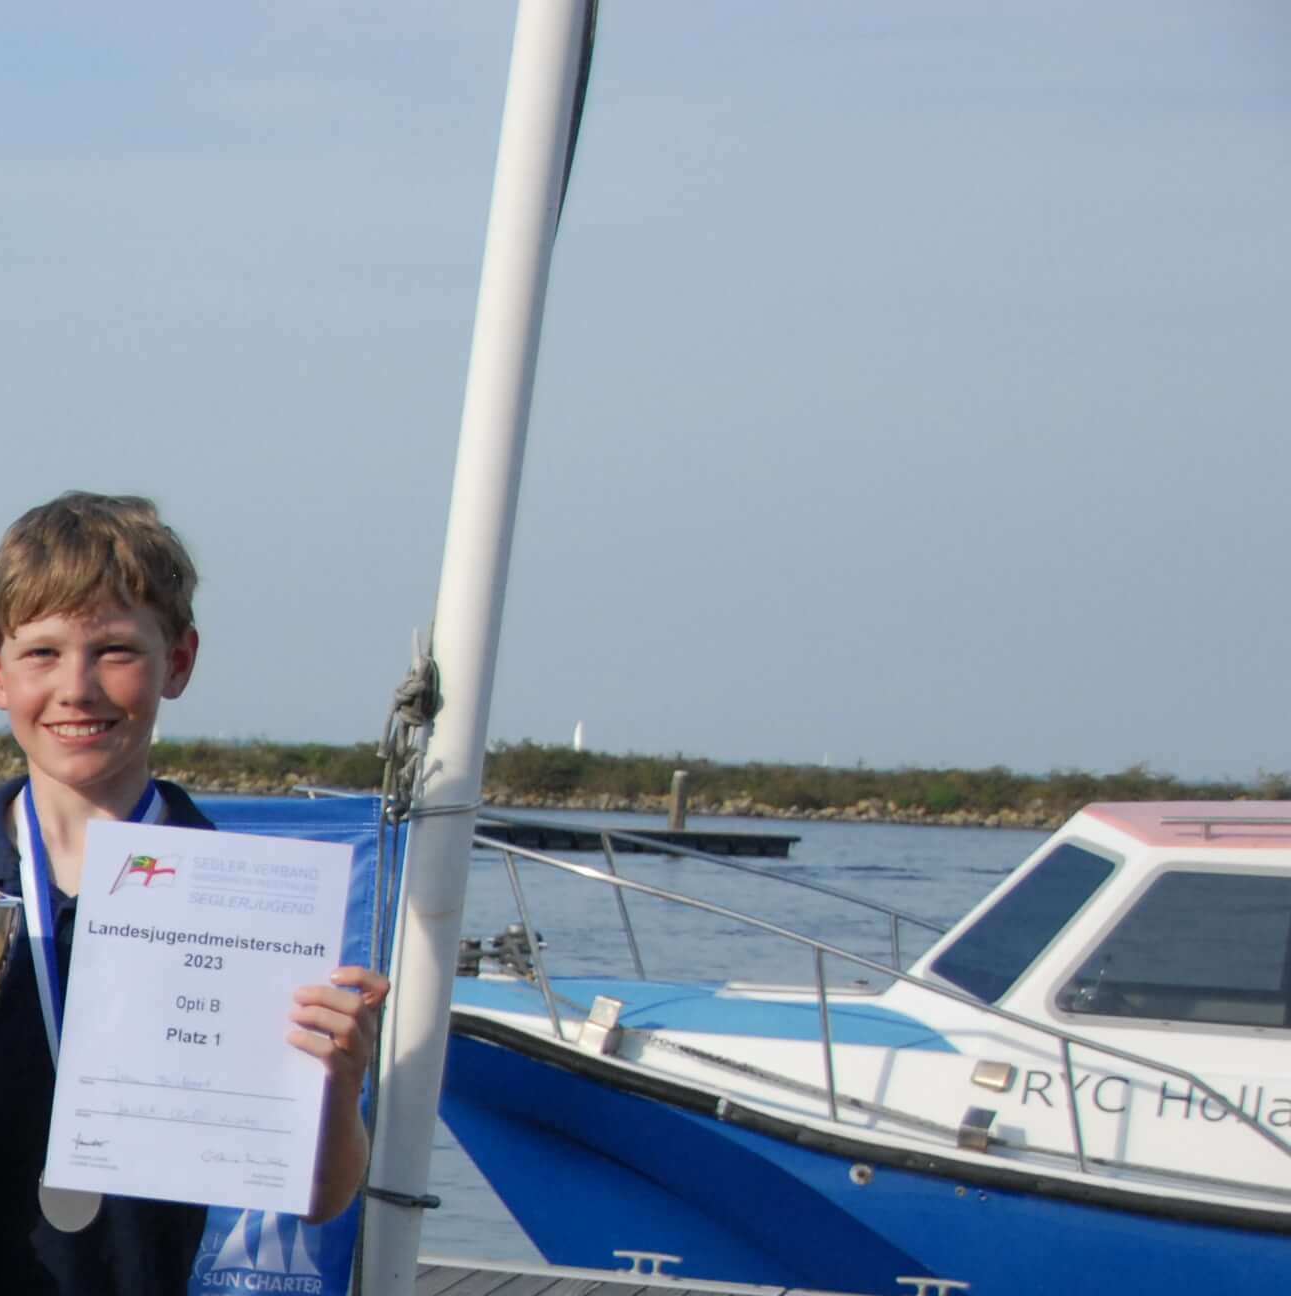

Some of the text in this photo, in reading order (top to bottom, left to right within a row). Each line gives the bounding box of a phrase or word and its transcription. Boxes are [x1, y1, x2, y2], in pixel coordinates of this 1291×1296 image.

[88, 920, 326, 958] Landesjugendmeisterschaft
[184, 953, 223, 971] 2023
[176, 996, 220, 1014] Opti B
[166, 1028, 221, 1046] Platz 1
[1021, 1069, 1131, 1113] RYC
[202, 1272, 322, 1296] SUN CHARTER
